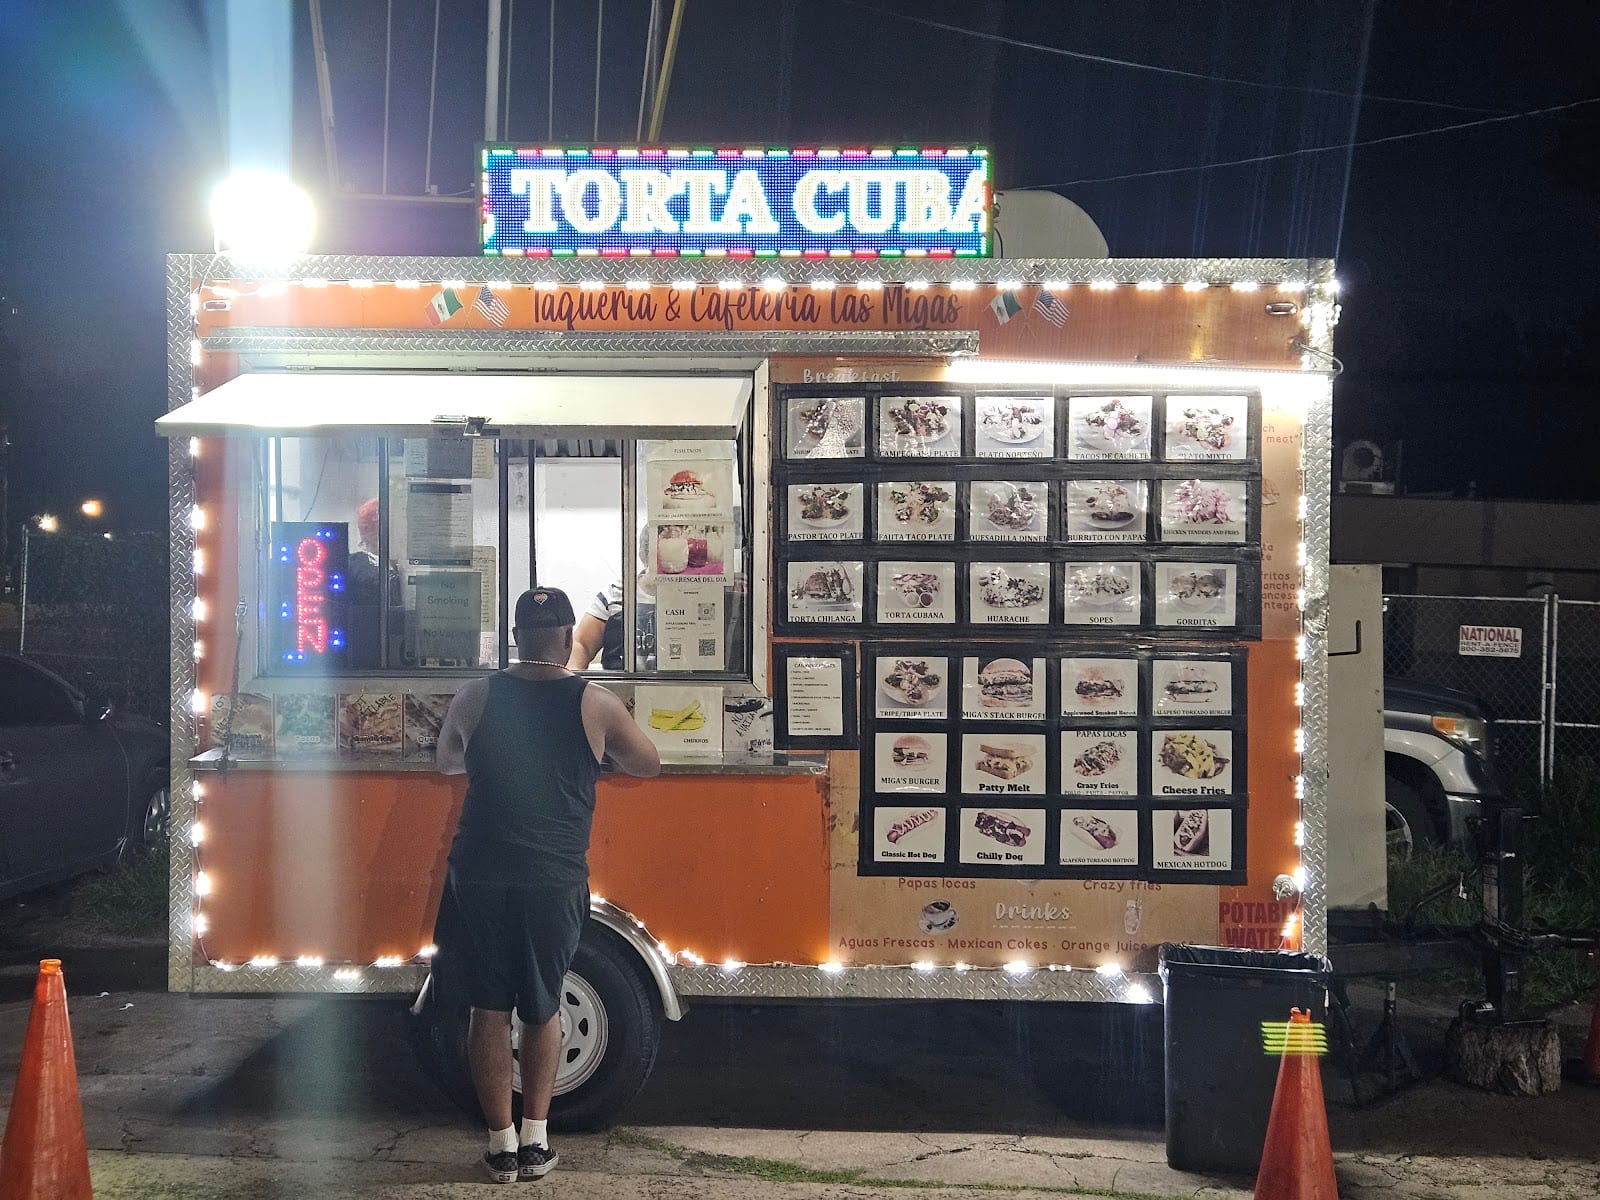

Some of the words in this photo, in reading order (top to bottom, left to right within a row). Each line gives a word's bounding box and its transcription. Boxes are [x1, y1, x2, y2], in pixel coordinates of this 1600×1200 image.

[510, 169, 779, 233] TORTA
[665, 288, 681, 322] &
[881, 285, 964, 330] Migas
[819, 532, 838, 540] TACO
[928, 533, 953, 541] PLATE
[970, 534, 1018, 542] QUESADILLA
[1122, 533, 1147, 541] PAPAS
[297, 538, 326, 654] OPEN
[790, 615, 816, 623] TORTA
[817, 615, 856, 623] CHILANGA
[885, 611, 911, 619] TORTA
[912, 611, 944, 619] CUBANA
[987, 615, 1030, 623] HUARACHE
[1089, 616, 1114, 624] SOPES
[1460, 627, 1520, 643] NATIONAL
[962, 711, 989, 719] MIGA'S
[880, 776, 907, 785] MIGA'S
[908, 777, 940, 785] BURGER
[978, 783, 1005, 793] Patty
[1007, 783, 1031, 793] Melt
[1076, 782, 1099, 790] Crazy
[1162, 785, 1198, 795] Cheese
[1200, 786, 1226, 795] Fries
[881, 851, 907, 859] Classic
[907, 851, 921, 859] Hot
[922, 852, 937, 860] Dog
[976, 852, 1003, 861] Chilly
[1005, 853, 1024, 861] Dog
[898, 878, 938, 890] Papas
[1083, 880, 1125, 892] Crazy
[995, 902, 1073, 921] Drinks
[839, 936, 879, 949] Aguas
[883, 936, 935, 948] Frescas
[947, 938, 1003, 949] Mexican
[1007, 938, 1048, 950] Cokes
[1061, 939, 1110, 953] Orange
[1116, 939, 1148, 953] Juice
